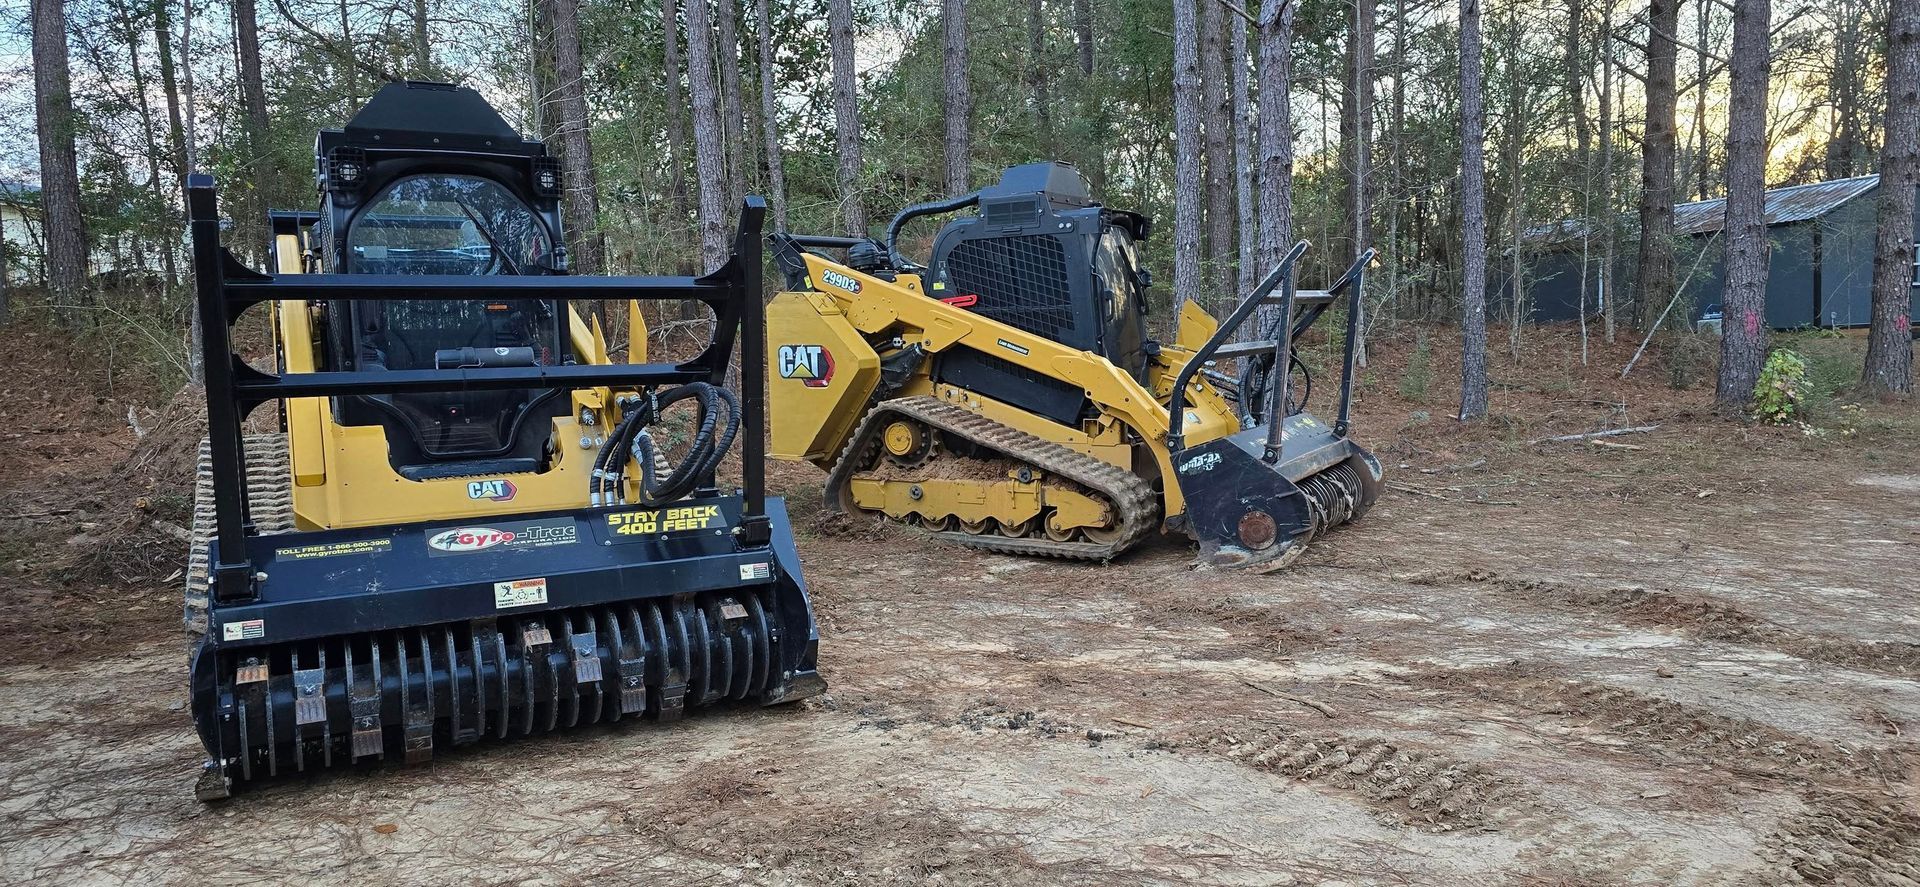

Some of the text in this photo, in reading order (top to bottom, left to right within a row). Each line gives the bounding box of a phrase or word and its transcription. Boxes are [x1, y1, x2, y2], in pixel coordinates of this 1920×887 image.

[822, 269, 855, 291] 299D3
[779, 346, 821, 378] CAT
[468, 480, 504, 498] CAT
[608, 505, 718, 525] STAY BACK
[616, 517, 710, 535] 400 FEET
[277, 548, 301, 556] TOLL
[295, 546, 374, 559] www.gyrotrac.com
